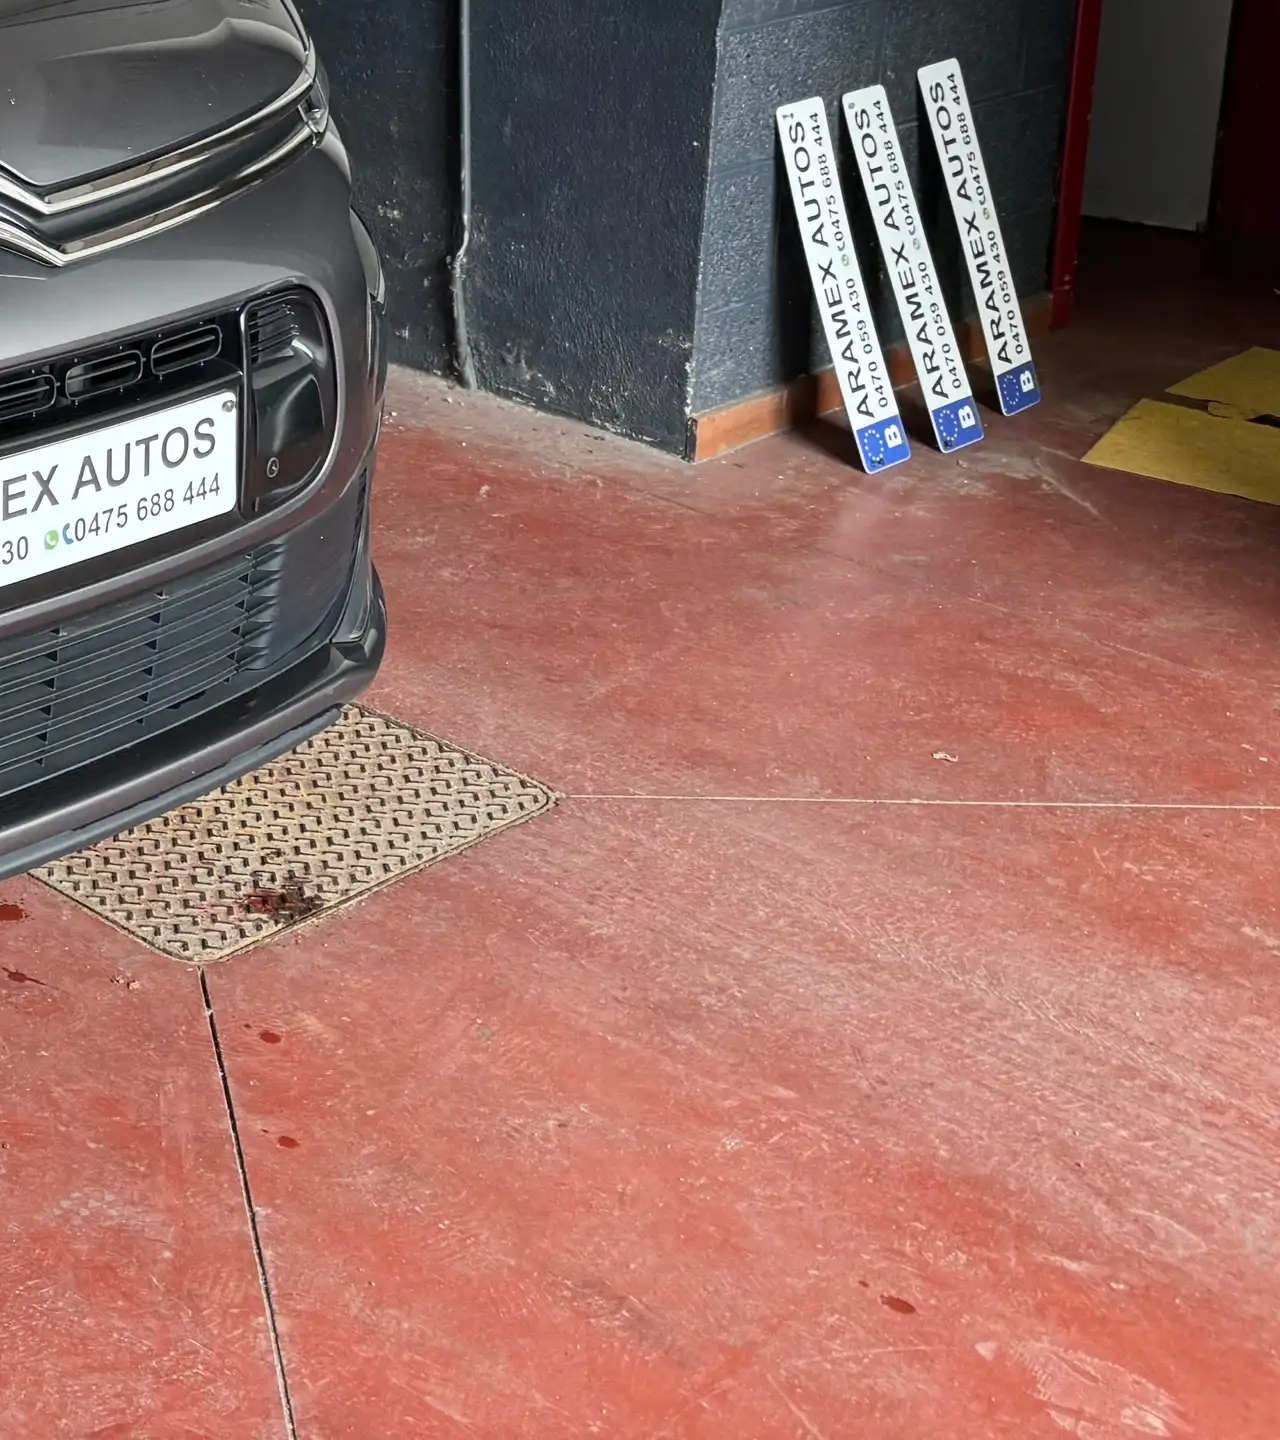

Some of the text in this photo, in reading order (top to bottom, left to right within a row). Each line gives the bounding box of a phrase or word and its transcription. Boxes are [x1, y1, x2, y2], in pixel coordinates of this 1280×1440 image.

[946, 72, 961, 106] 444
[809, 112, 823, 147] 444
[873, 100, 888, 134] 444
[956, 112, 971, 145] 688
[817, 153, 832, 188] 688
[884, 140, 900, 174] 688
[929, 81, 1012, 364] ARAMEX AUTOS
[855, 108, 949, 399] ARAMEX AUTOS
[987, 230, 1001, 264] 430
[788, 121, 875, 418] ARAMEX AUTOS
[918, 261, 933, 296] 430
[997, 270, 1011, 303] 059
[845, 278, 860, 313] 430
[931, 302, 946, 336] 059
[1006, 309, 1024, 354] 0470
[856, 320, 872, 354] 059
[942, 343, 962, 389] 0470
[1019, 370, 1035, 393] B
[869, 361, 888, 408] 0470
[957, 405, 975, 429] B
[884, 424, 902, 448] B
[71, 417, 217, 500] AUTOS
[73, 508, 129, 543] 0475
[136, 494, 175, 522] 688
[182, 473, 221, 503] 444
